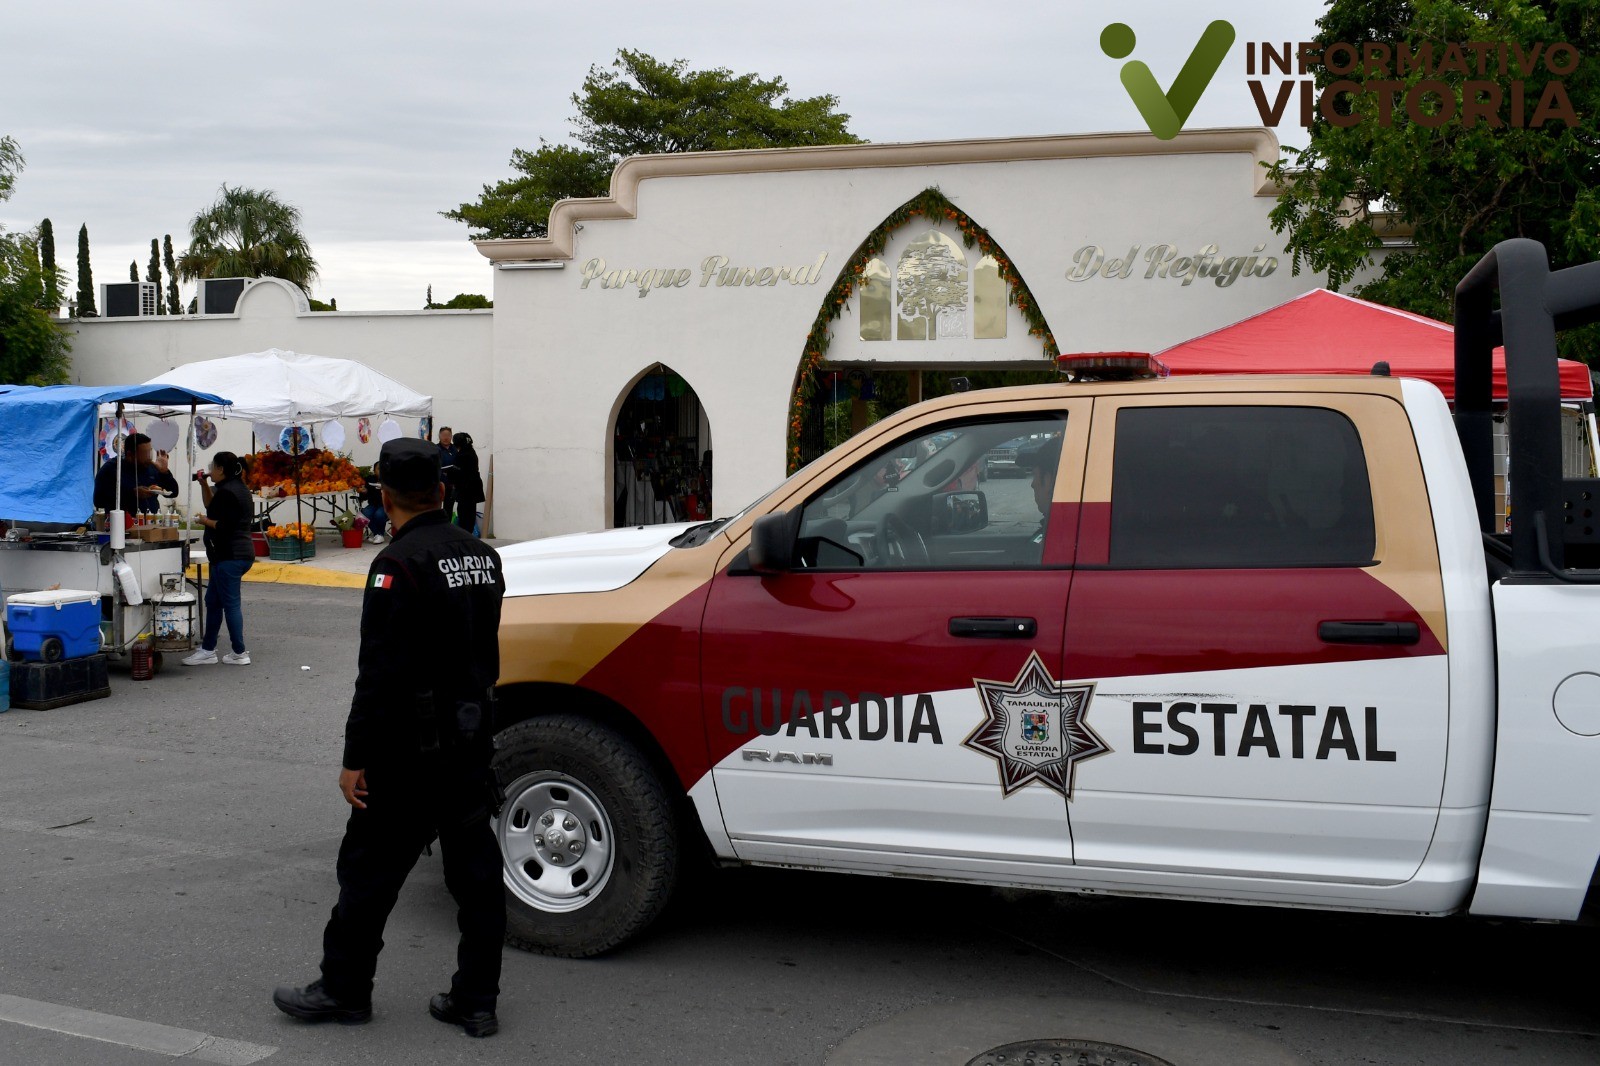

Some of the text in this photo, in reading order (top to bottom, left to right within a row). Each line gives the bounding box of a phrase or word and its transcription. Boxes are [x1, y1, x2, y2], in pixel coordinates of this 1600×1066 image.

[579, 250, 829, 298] Parque Funeral
[1065, 243, 1279, 288] Del Refugio
[438, 555, 496, 574] GUARDIA
[446, 570, 496, 588] ESTATAL
[721, 686, 1397, 762] GUARDIA ESTATAL
[742, 748, 834, 766] RAM
[1014, 744, 1059, 752] GUARDIA
